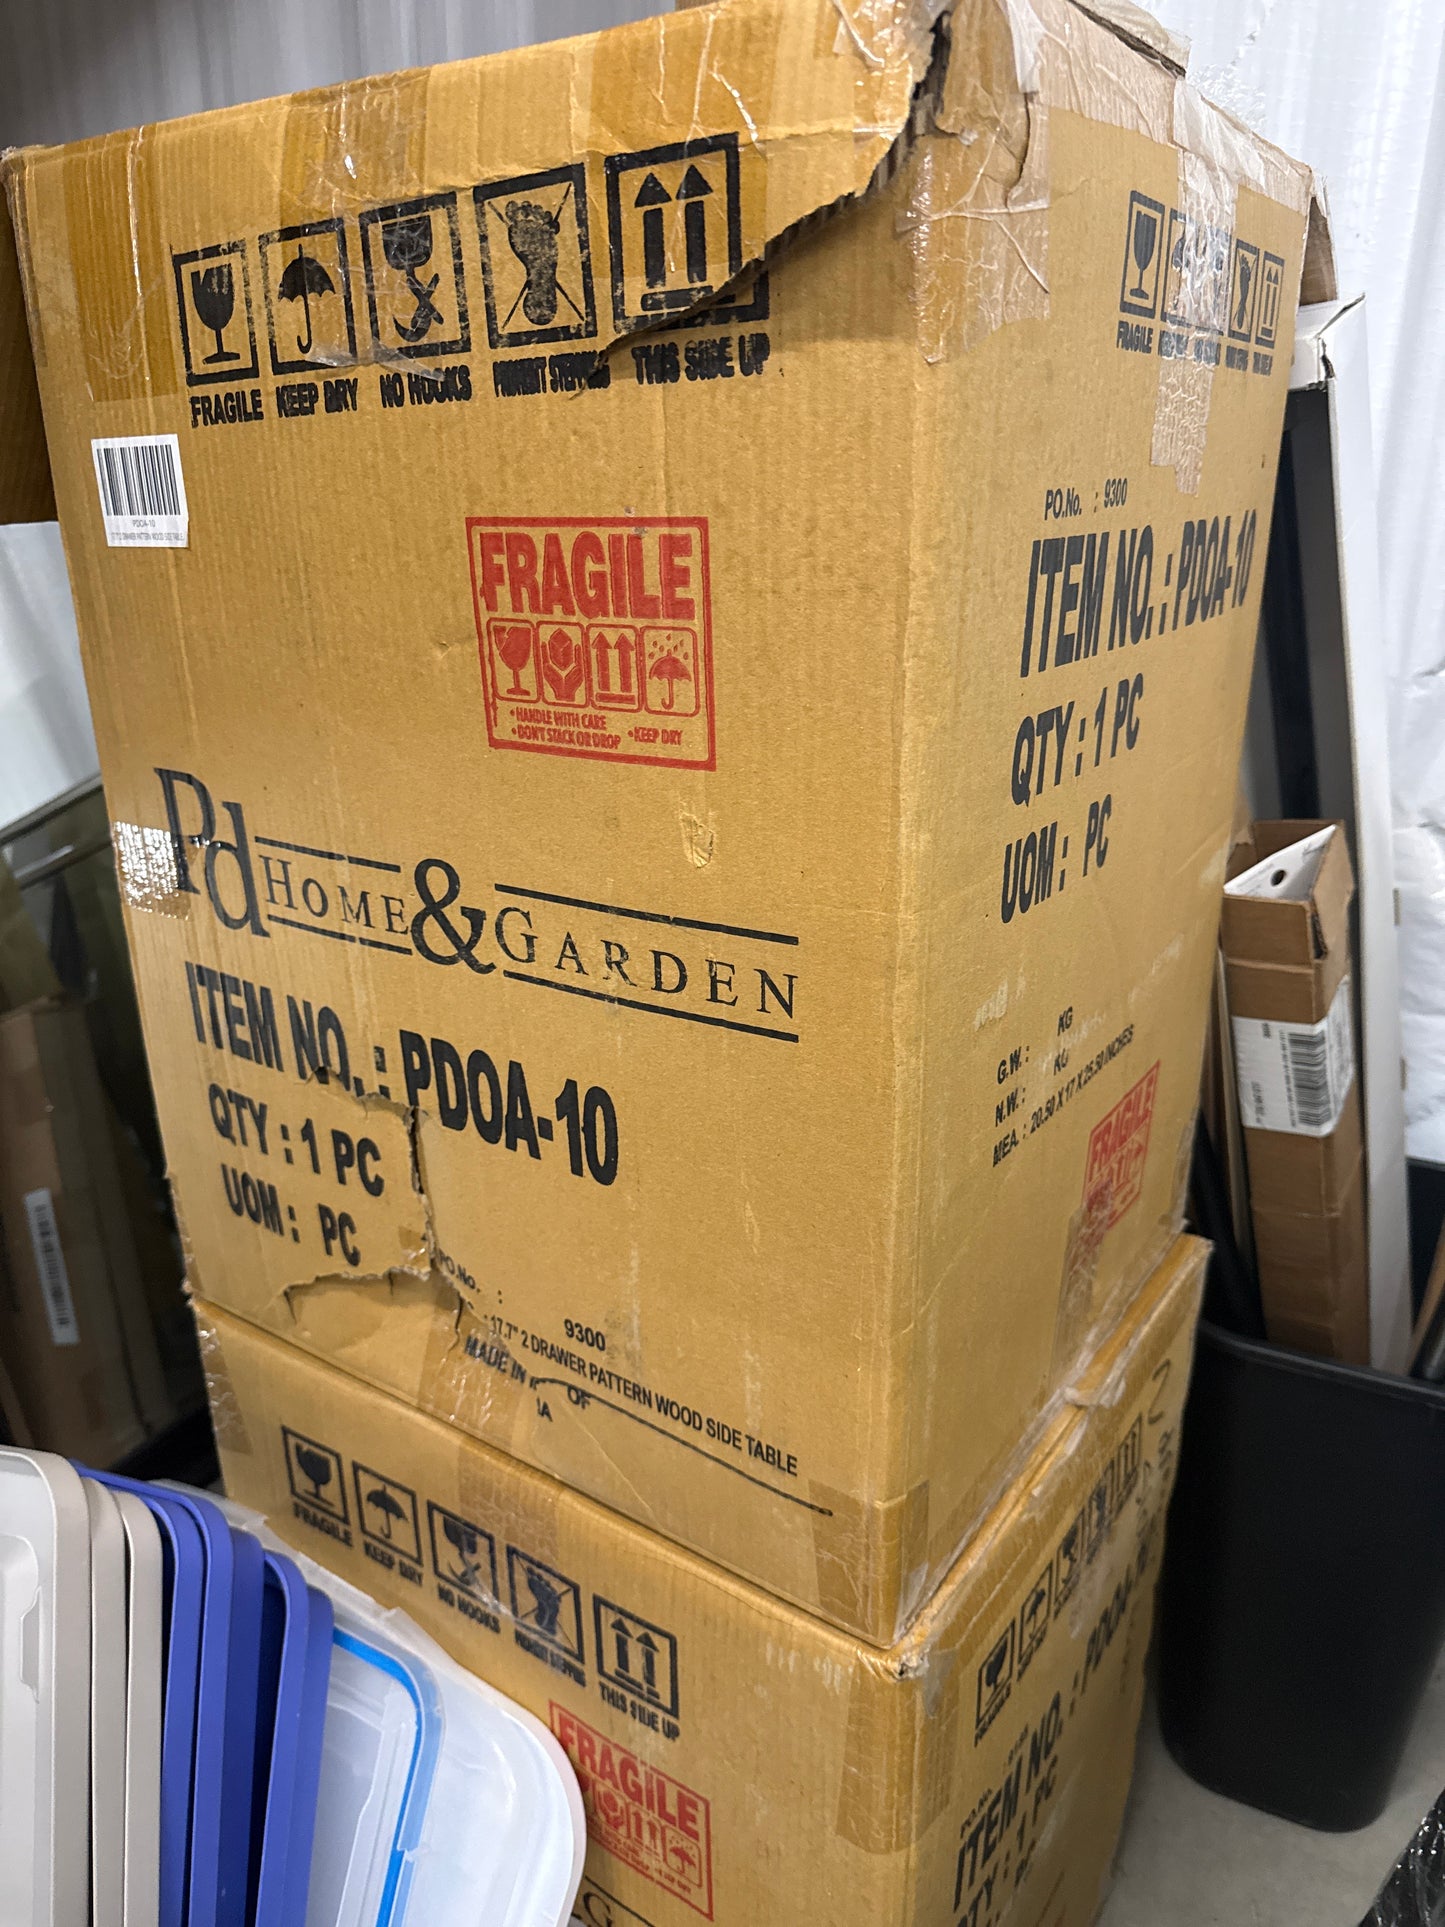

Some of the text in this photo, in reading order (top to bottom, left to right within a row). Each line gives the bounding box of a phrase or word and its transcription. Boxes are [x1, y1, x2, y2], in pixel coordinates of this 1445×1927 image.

[631, 341, 681, 386] THIS
[685, 337, 736, 381] SIDE
[738, 332, 771, 377] UP
[1116, 320, 1154, 353] FRAGILE
[190, 388, 264, 428] FRAGILE
[276, 377, 359, 418] KEEP DRY
[379, 373, 405, 408] NO
[407, 365, 473, 405] HOOKS
[1104, 477, 1129, 509] 9300
[480, 531, 696, 621] FRAGILE
[1020, 530, 1110, 678] ITEM
[1172, 508, 1257, 632] PDOA-10
[515, 706, 607, 731] HANDLE WITH CARE
[547, 727, 576, 745] STACK
[576, 731, 591, 747] OR
[591, 733, 622, 750] DROP
[634, 726, 683, 746] KEEP DRY
[1110, 672, 1144, 758] PC
[1083, 794, 1112, 878] PC
[411, 857, 498, 976] &
[494, 905, 799, 1021] GARDEN
[1057, 1006, 1073, 1037] KG
[184, 961, 285, 1073] ITEM
[399, 1028, 619, 1187] PDOA-10
[330, 1128, 386, 1198] PC
[317, 1203, 362, 1267] PC
[464, 1334, 510, 1375] MADE
[563, 1318, 607, 1352] 9300
[520, 1330, 529, 1349] 2
[530, 1334, 587, 1378] DRAWER
[589, 1362, 652, 1409] PATTERN
[655, 1392, 703, 1432] WOOD
[706, 1417, 743, 1451] SIDE
[744, 1433, 798, 1477] TABLE
[599, 1679, 628, 1714] THIS
[662, 1716, 681, 1742] UP
[558, 1712, 700, 1842] FRAGILE
